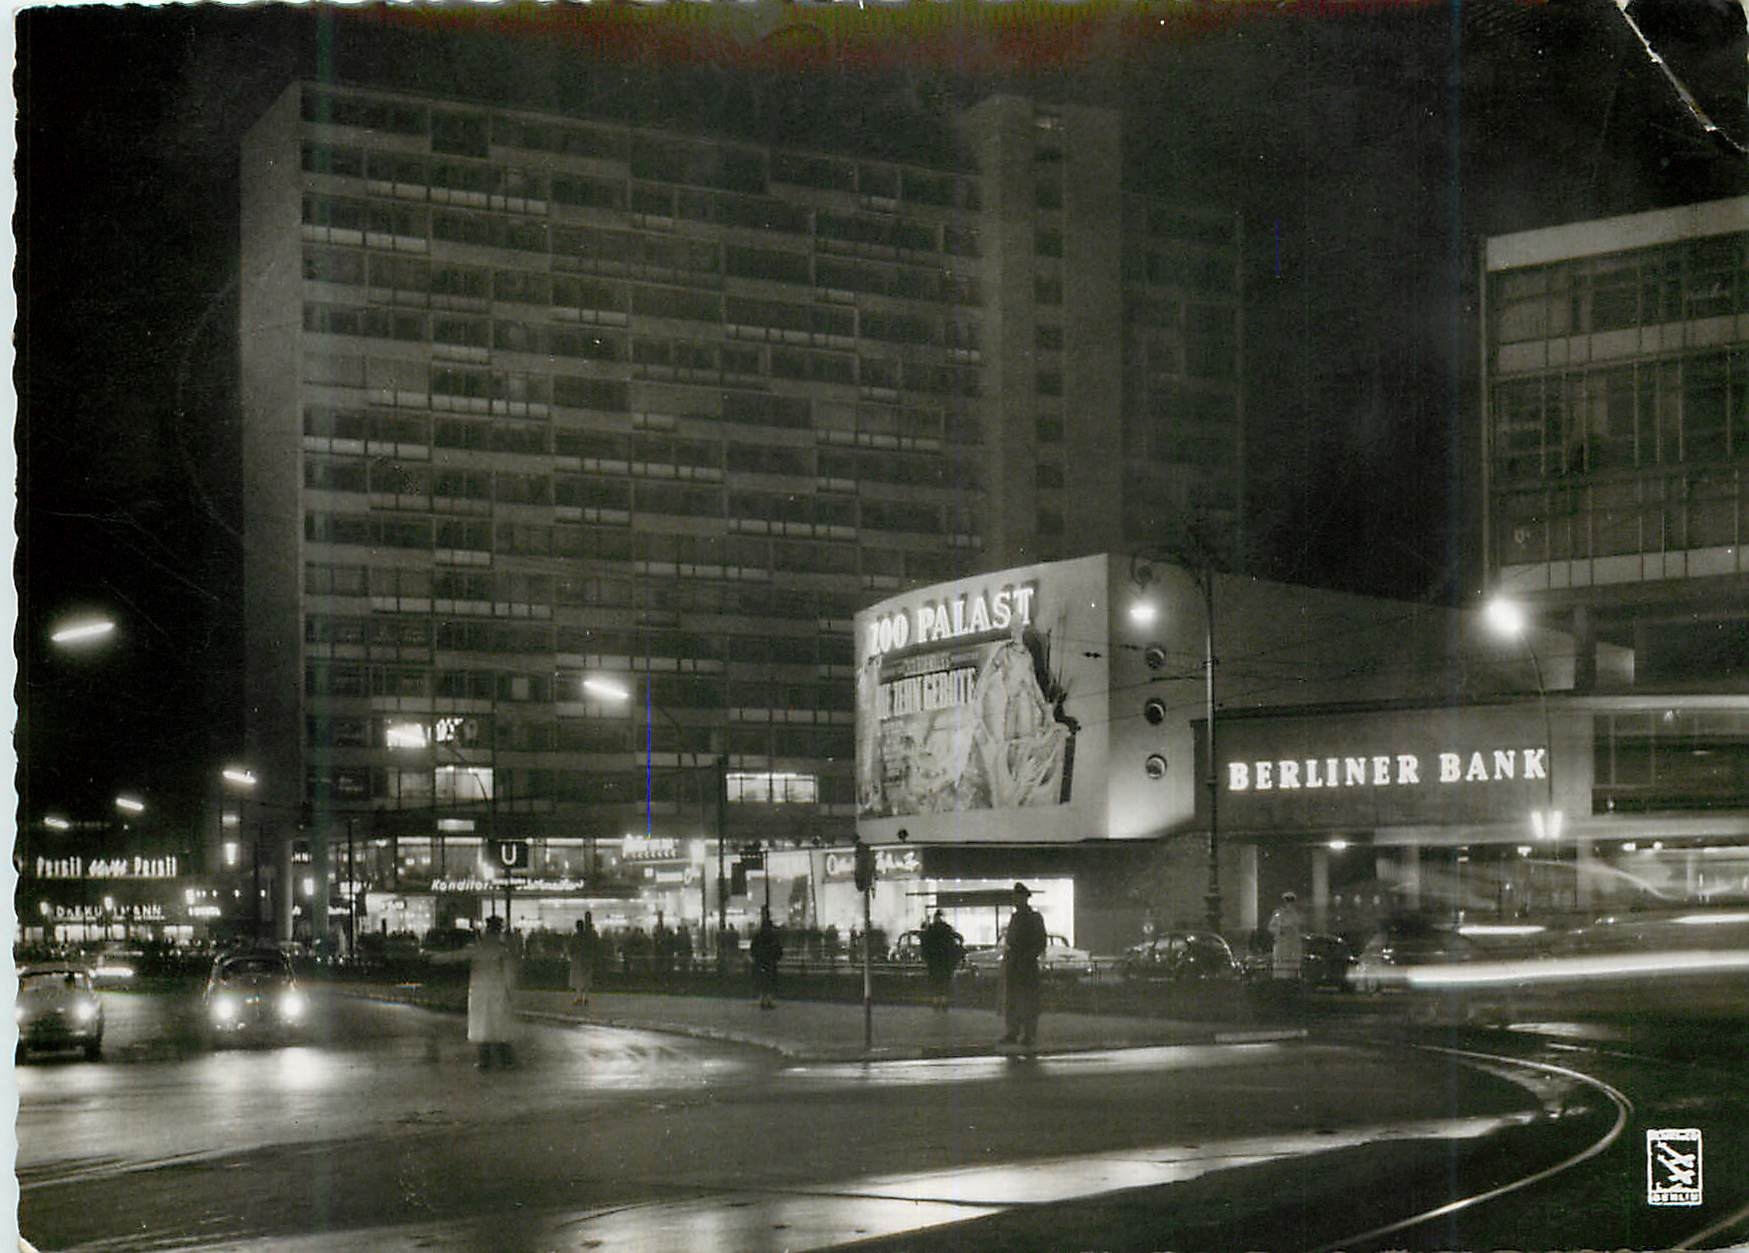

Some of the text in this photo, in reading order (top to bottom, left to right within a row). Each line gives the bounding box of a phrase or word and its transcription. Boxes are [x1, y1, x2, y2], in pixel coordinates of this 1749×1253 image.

[917, 588, 1034, 643] PALAST
[1228, 749, 1546, 791] BERLINER BANK
[502, 843, 516, 865] U
